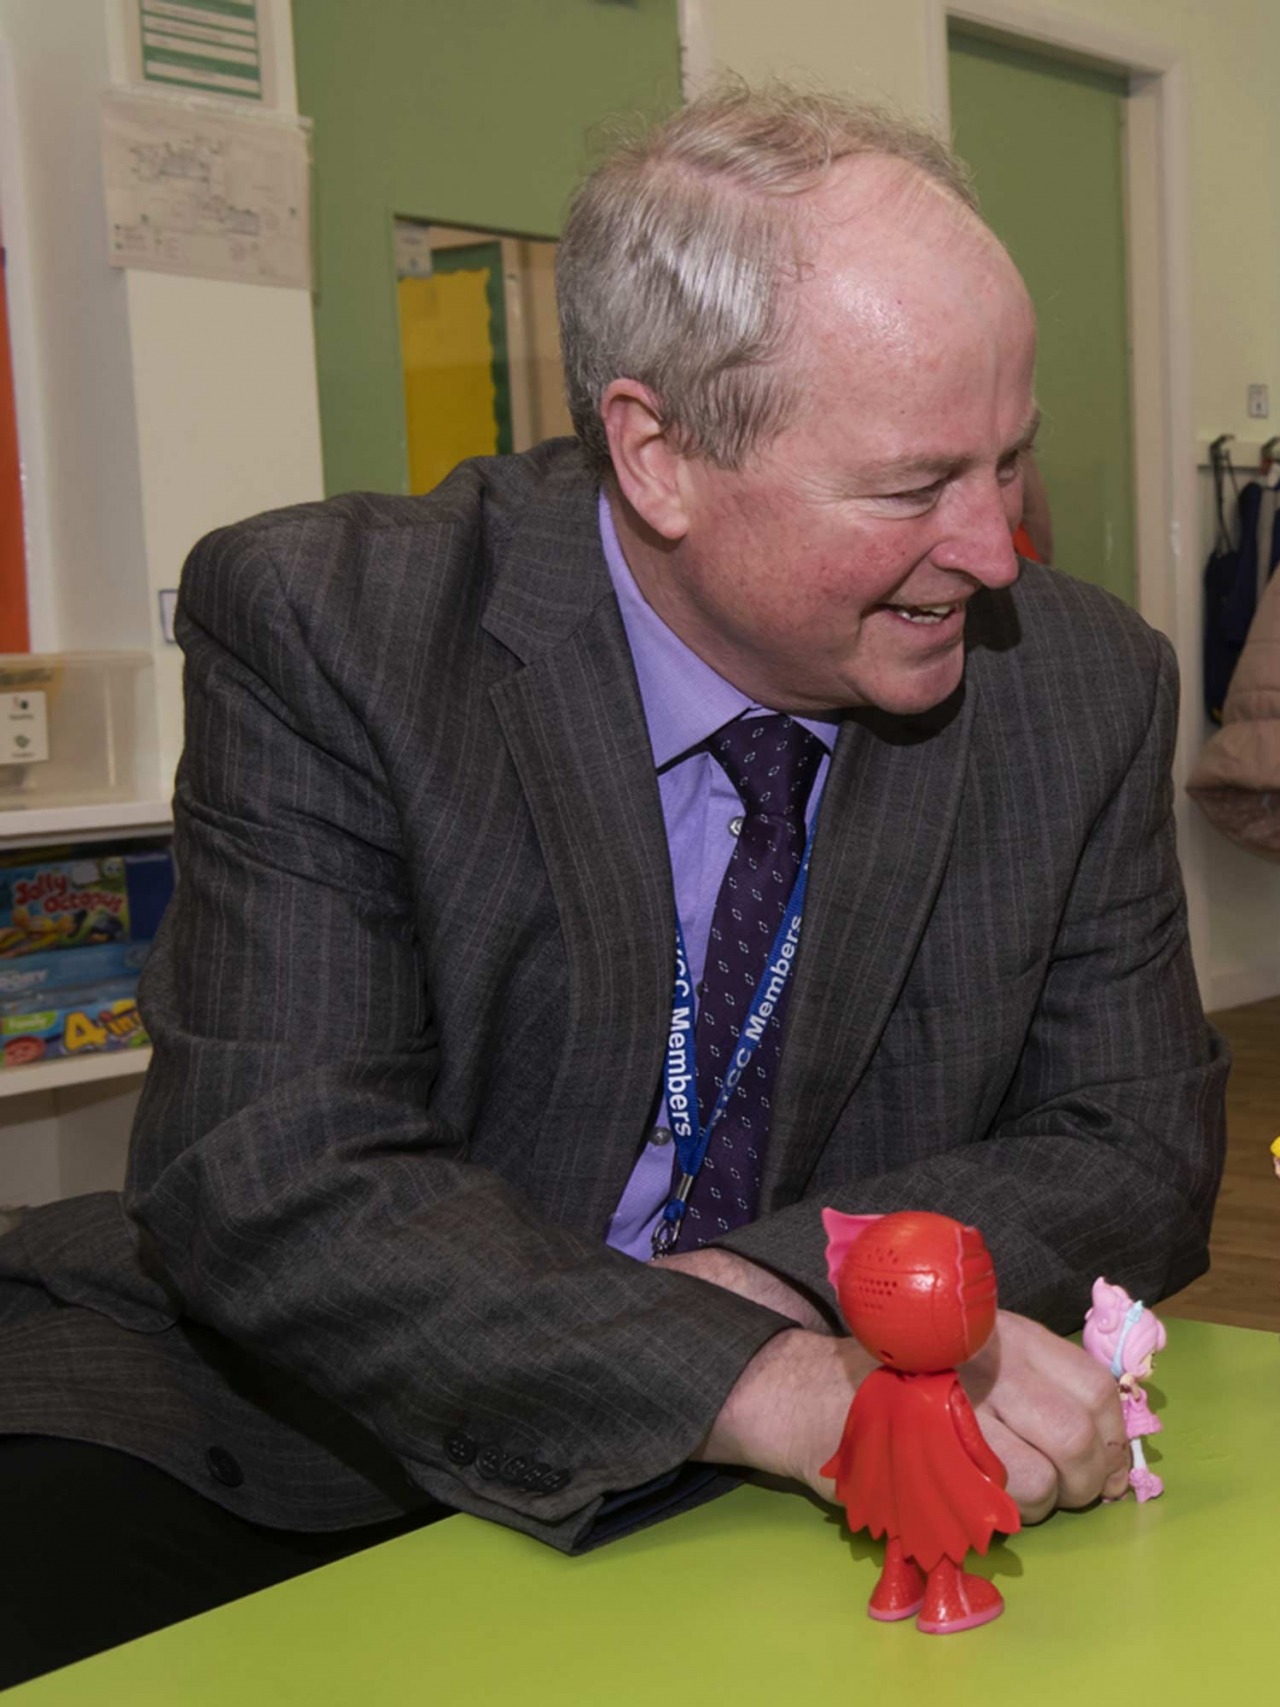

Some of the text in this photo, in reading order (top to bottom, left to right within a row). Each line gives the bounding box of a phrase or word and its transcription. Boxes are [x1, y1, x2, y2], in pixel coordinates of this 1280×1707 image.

[15, 872, 68, 906] Jolly
[745, 915, 803, 1042] Members
[64, 1010, 108, 1051] 4
[668, 1006, 693, 1137] Members
